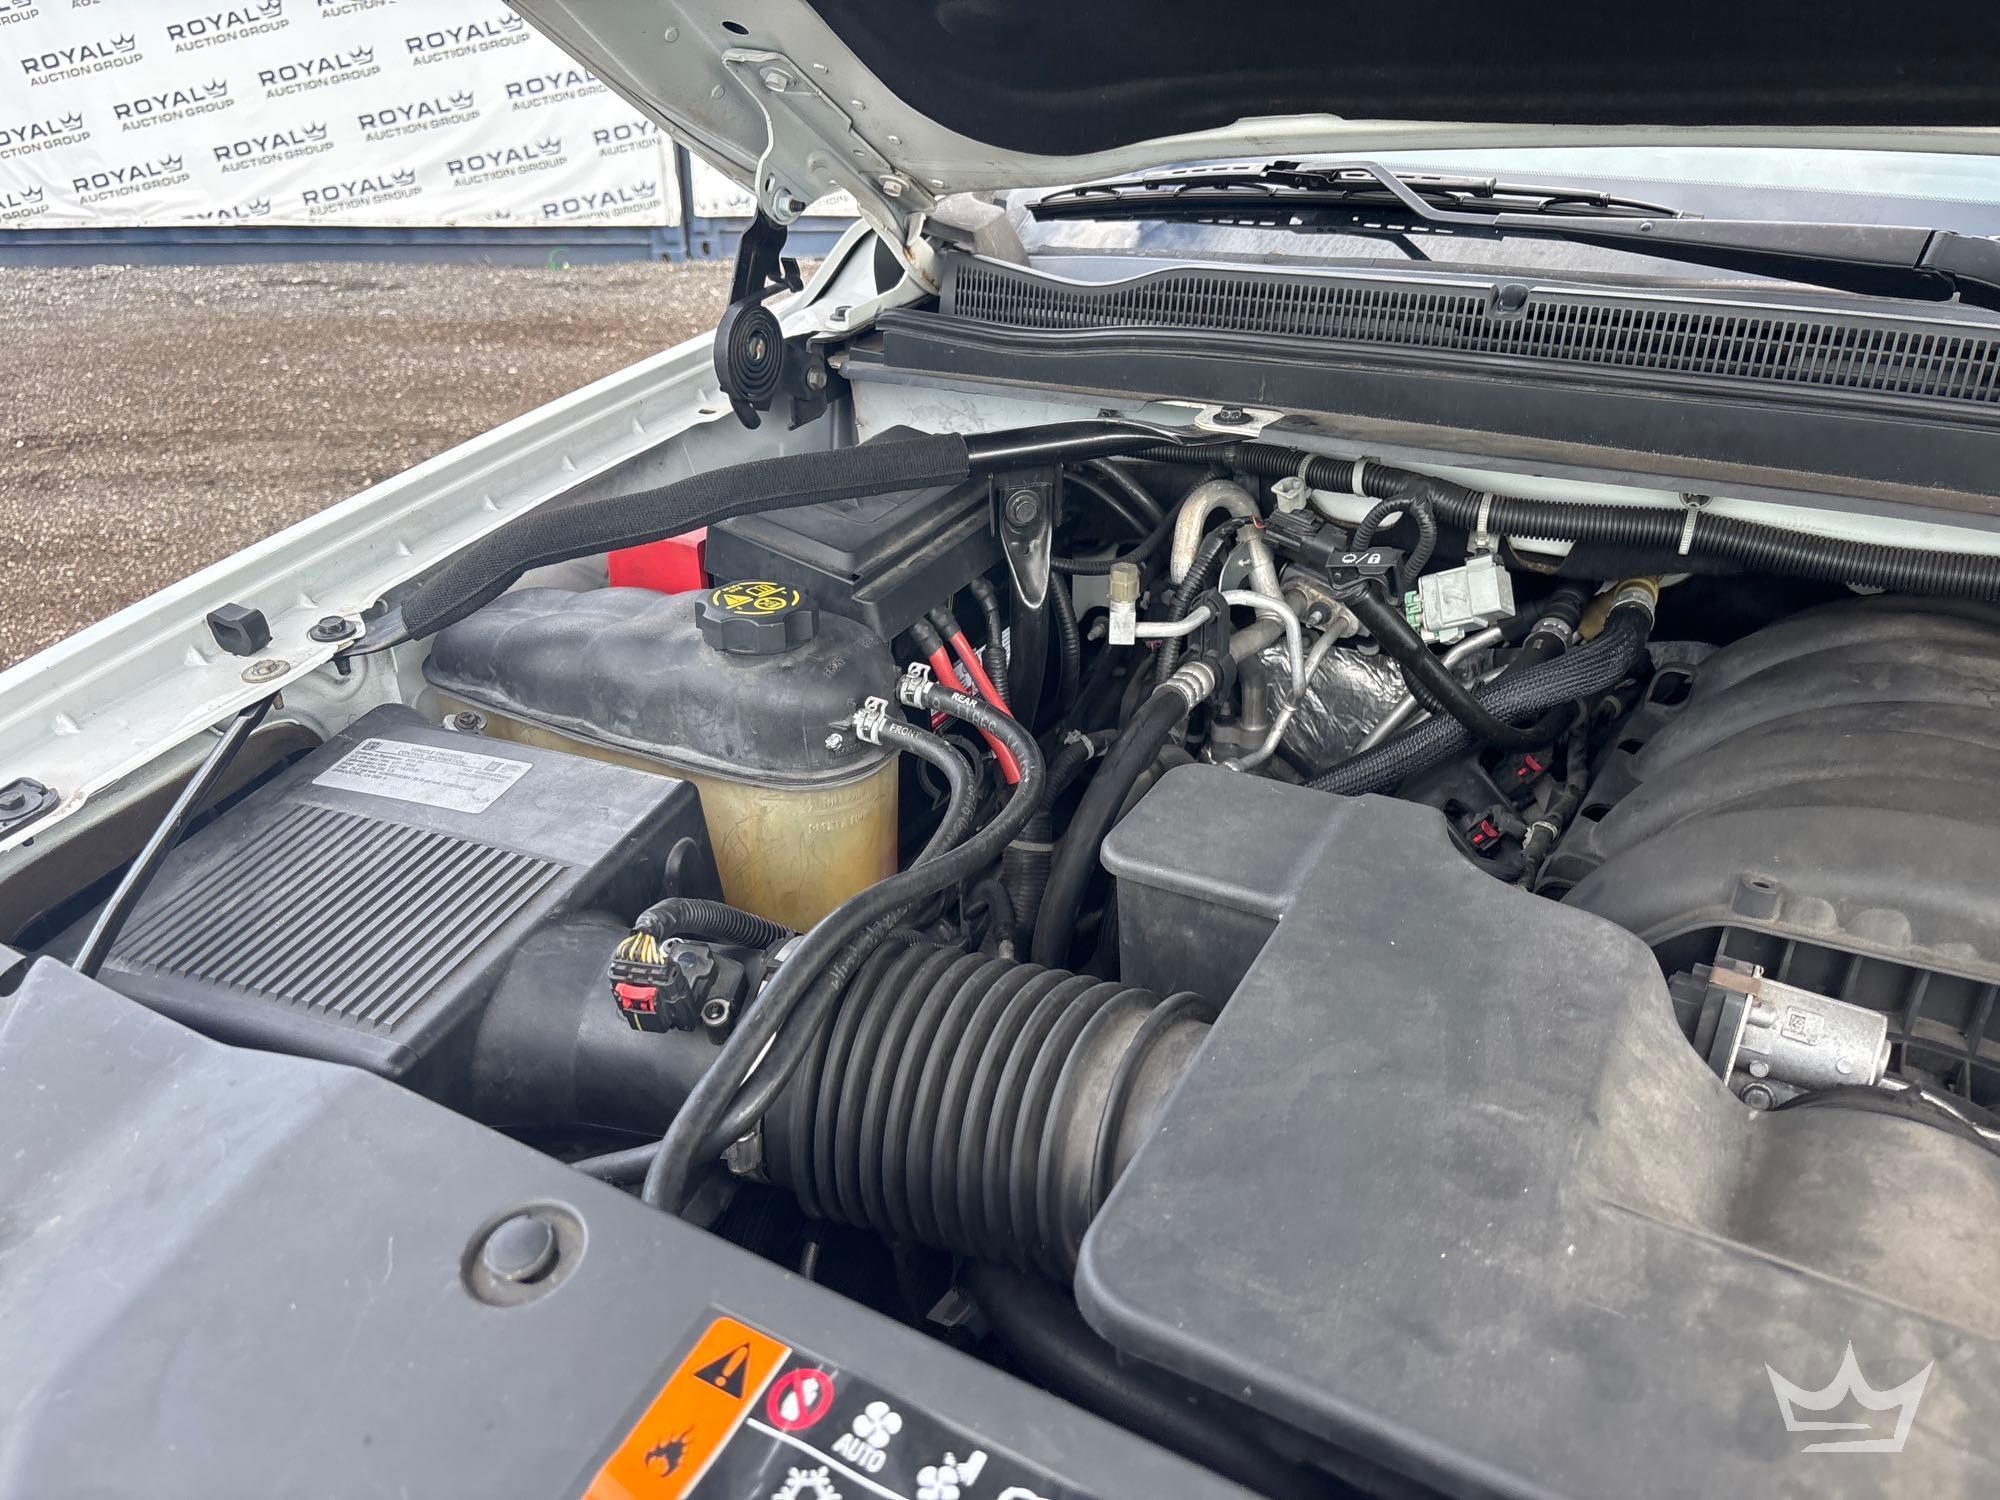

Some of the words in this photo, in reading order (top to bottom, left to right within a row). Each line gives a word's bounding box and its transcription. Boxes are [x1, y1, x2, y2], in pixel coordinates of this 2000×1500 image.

[0, 9, 39, 26] ROUP
[167, 8, 260, 41] ROYAL
[175, 32, 238, 54] AUCTION
[239, 19, 290, 39] GROUP
[406, 20, 502, 54] ROYAL
[412, 45, 477, 66] AUCTION
[480, 32, 531, 52] GROUP
[21, 42, 114, 75] ROYAL
[30, 65, 92, 87] AUCTION
[93, 53, 144, 74] GROUP
[258, 53, 351, 87] ROYAL
[265, 76, 329, 99] AUCTION
[330, 65, 381, 85] GROUP
[113, 87, 206, 120] ROYAL
[121, 111, 184, 133] AUCTION
[185, 98, 235, 118] GROUP
[358, 97, 450, 131] ROYAL
[511, 90, 575, 112] AUCTION
[0, 120, 63, 147] OYAL
[365, 121, 429, 142] AUCTION
[430, 109, 480, 130] GROUP
[593, 121, 659, 146] ROY
[0, 142, 41, 160] CTION
[43, 131, 91, 149] GROUP
[214, 130, 305, 163] ROYAL
[221, 152, 283, 174] AUCTION
[284, 140, 334, 161] GROUP
[447, 145, 538, 177] ROYAL
[72, 161, 162, 194] ROYAL
[454, 167, 516, 188] AUCTION
[518, 155, 567, 175] GROUP
[79, 184, 142, 205] AUCTION
[142, 173, 190, 192] GROUP
[302, 175, 394, 206] ROYAL
[542, 188, 634, 219] ROYAL
[308, 196, 371, 217] AUCTION
[951, 692, 978, 708] REAR
[889, 723, 922, 740] FRONT
[831, 1432, 887, 1473] AUTO
